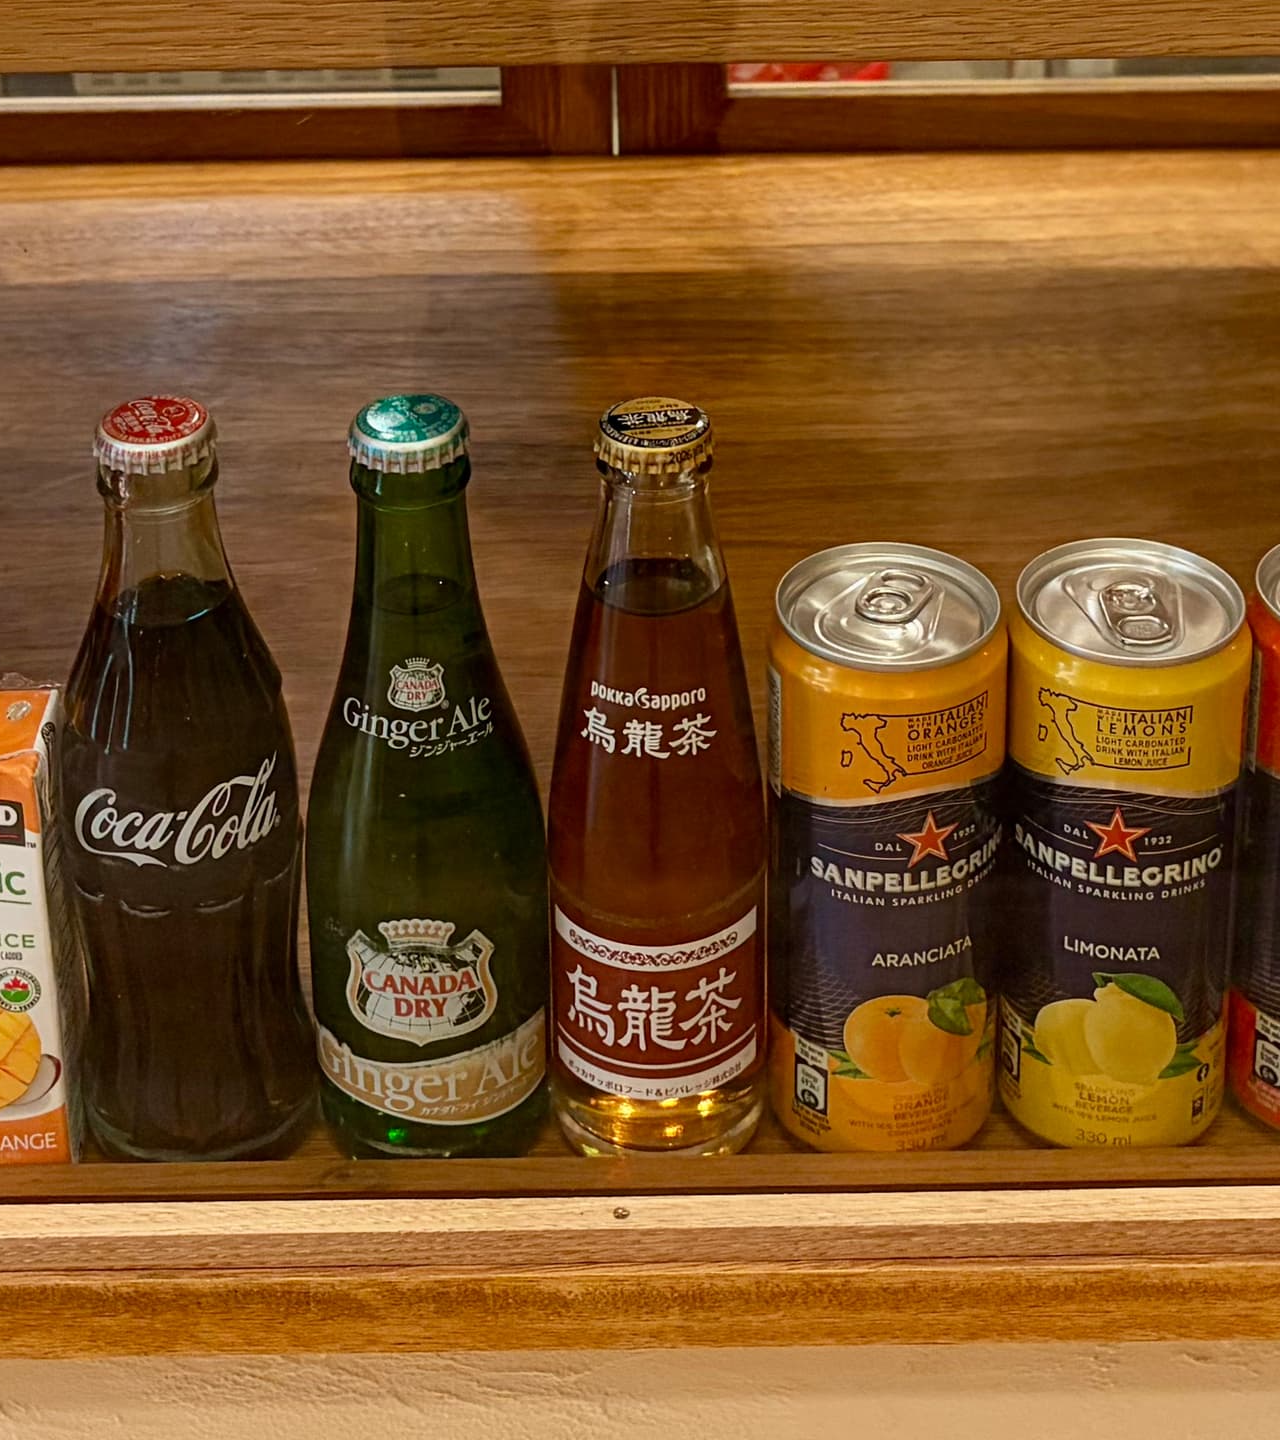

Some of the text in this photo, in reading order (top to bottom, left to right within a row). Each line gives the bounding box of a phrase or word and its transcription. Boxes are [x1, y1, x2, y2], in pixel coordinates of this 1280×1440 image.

[395, 679, 439, 691] CANADA
[406, 691, 429, 702] DRY
[933, 696, 984, 726] ITALIAN
[1123, 710, 1187, 725] ITALIAN
[342, 695, 493, 750] Ginger Ale
[581, 706, 718, 760] 烏龍茶
[908, 709, 984, 741] ORANGES
[1097, 720, 1186, 736] LEMONS
[907, 742, 932, 753] LIGHT
[1096, 736, 1186, 748] LIGHT CARBONATED
[1096, 745, 1123, 756] DRINK
[1126, 748, 1149, 757] WITH
[1114, 757, 1168, 767] LEMON JUICE
[75, 750, 278, 868] Coca-Cola
[1064, 823, 1172, 846] DAL 1932
[874, 842, 903, 852] DAL
[1015, 823, 1222, 888] SANPELLEGRINO
[1027, 859, 1206, 901] ITALIAN SPARKLING DRINKS
[831, 886, 963, 907] ITALIAN SPARKLING
[871, 935, 972, 968] ARANCIATA
[1063, 935, 1160, 962] LIMONATA
[364, 970, 477, 996] CANADA
[393, 997, 448, 1018] DRY
[566, 964, 743, 1051] 烏龍茶
[472, 1036, 538, 1098] Ale
[1079, 1091, 1130, 1106] LEMON
[1075, 1128, 1132, 1146] 330 ml
